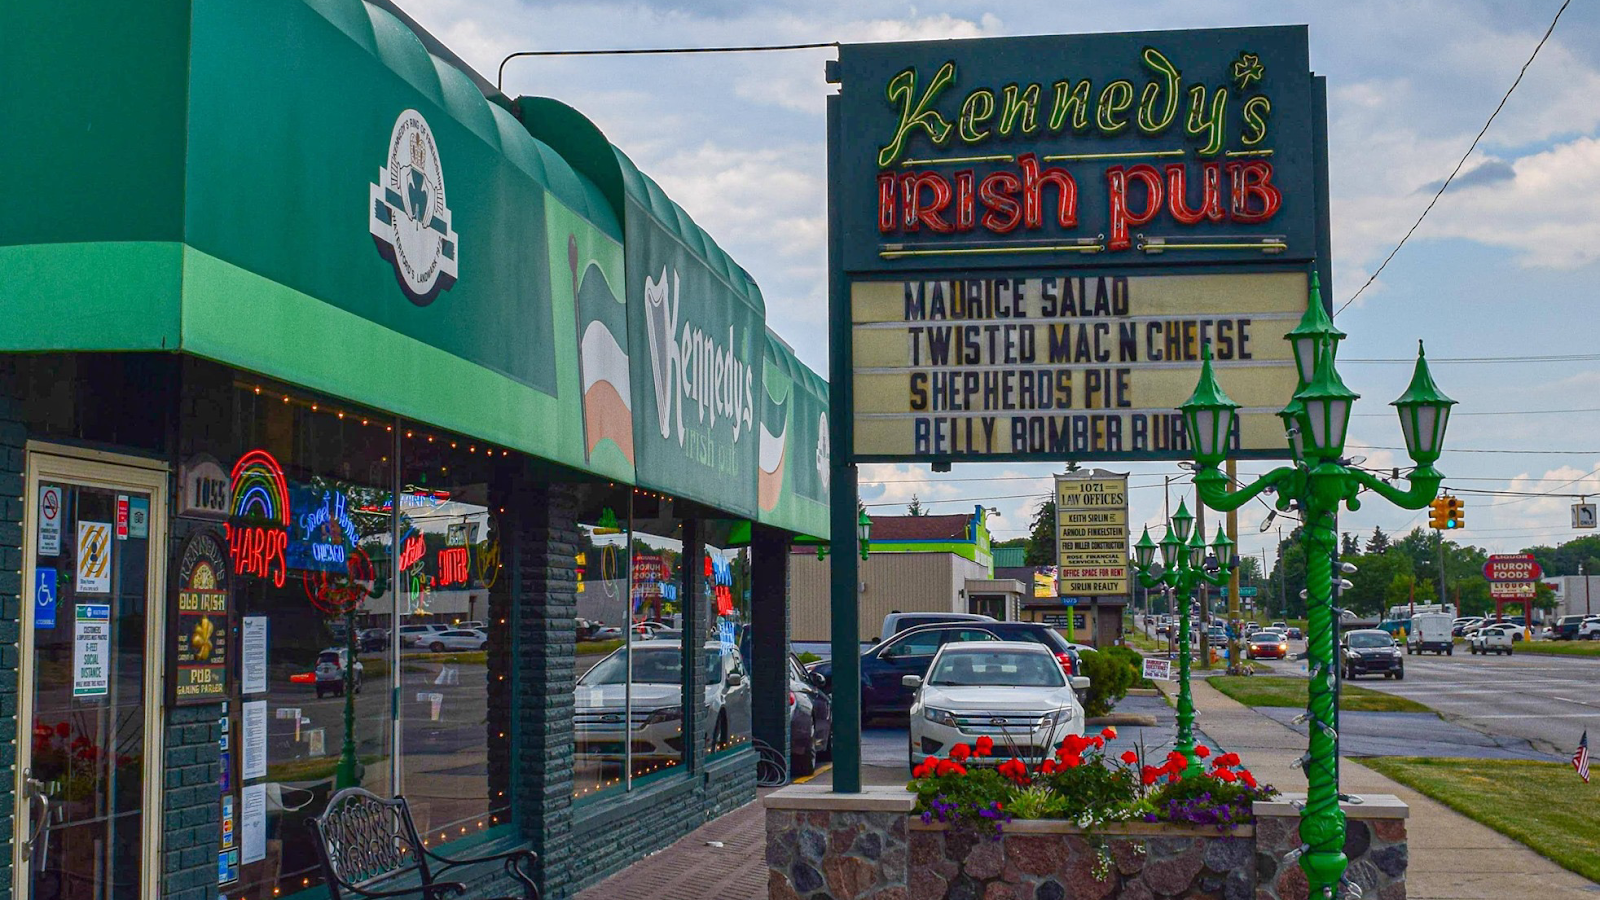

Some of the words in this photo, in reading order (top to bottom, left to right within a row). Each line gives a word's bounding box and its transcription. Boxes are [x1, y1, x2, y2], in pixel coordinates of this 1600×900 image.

[904, 277, 1026, 320] MAURICE
[1041, 276, 1129, 317] SALAD
[908, 324, 1035, 365] TWISTED
[1049, 322, 1110, 362] MAC
[1120, 322, 1137, 362] N
[1147, 319, 1252, 360] CHEESE
[910, 370, 1072, 411] SHEPHERDS
[1085, 368, 1131, 407] PIE
[915, 417, 996, 454] BELLY
[1011, 414, 1122, 452] BOMBER
[1132, 413, 1240, 450] BURR
[1080, 483, 1104, 492] 1071
[195, 477, 226, 510] 1055
[1062, 494, 1081, 505] LAW
[1083, 493, 1123, 505] OFFICES
[1069, 514, 1086, 522] KEITH
[1088, 514, 1108, 522] SIRLIN
[1088, 528, 1122, 536] FINKELSTEIN
[1063, 569, 1080, 577] OFFICE
[1082, 569, 1097, 577] SPACE
[1100, 568, 1109, 576] FOR
[1111, 568, 1123, 576] RENT
[1493, 571, 1529, 579] FOODS
[1070, 583, 1091, 591] SIRLIN
[1093, 582, 1118, 590] REALTY
[179, 593, 198, 610] OLD
[201, 594, 225, 611] IRISH
[84, 654, 99, 665] SOCIAL
[81, 667, 101, 678] DISTANCE
[190, 668, 211, 683] PUB
[177, 684, 199, 694] GAMING
